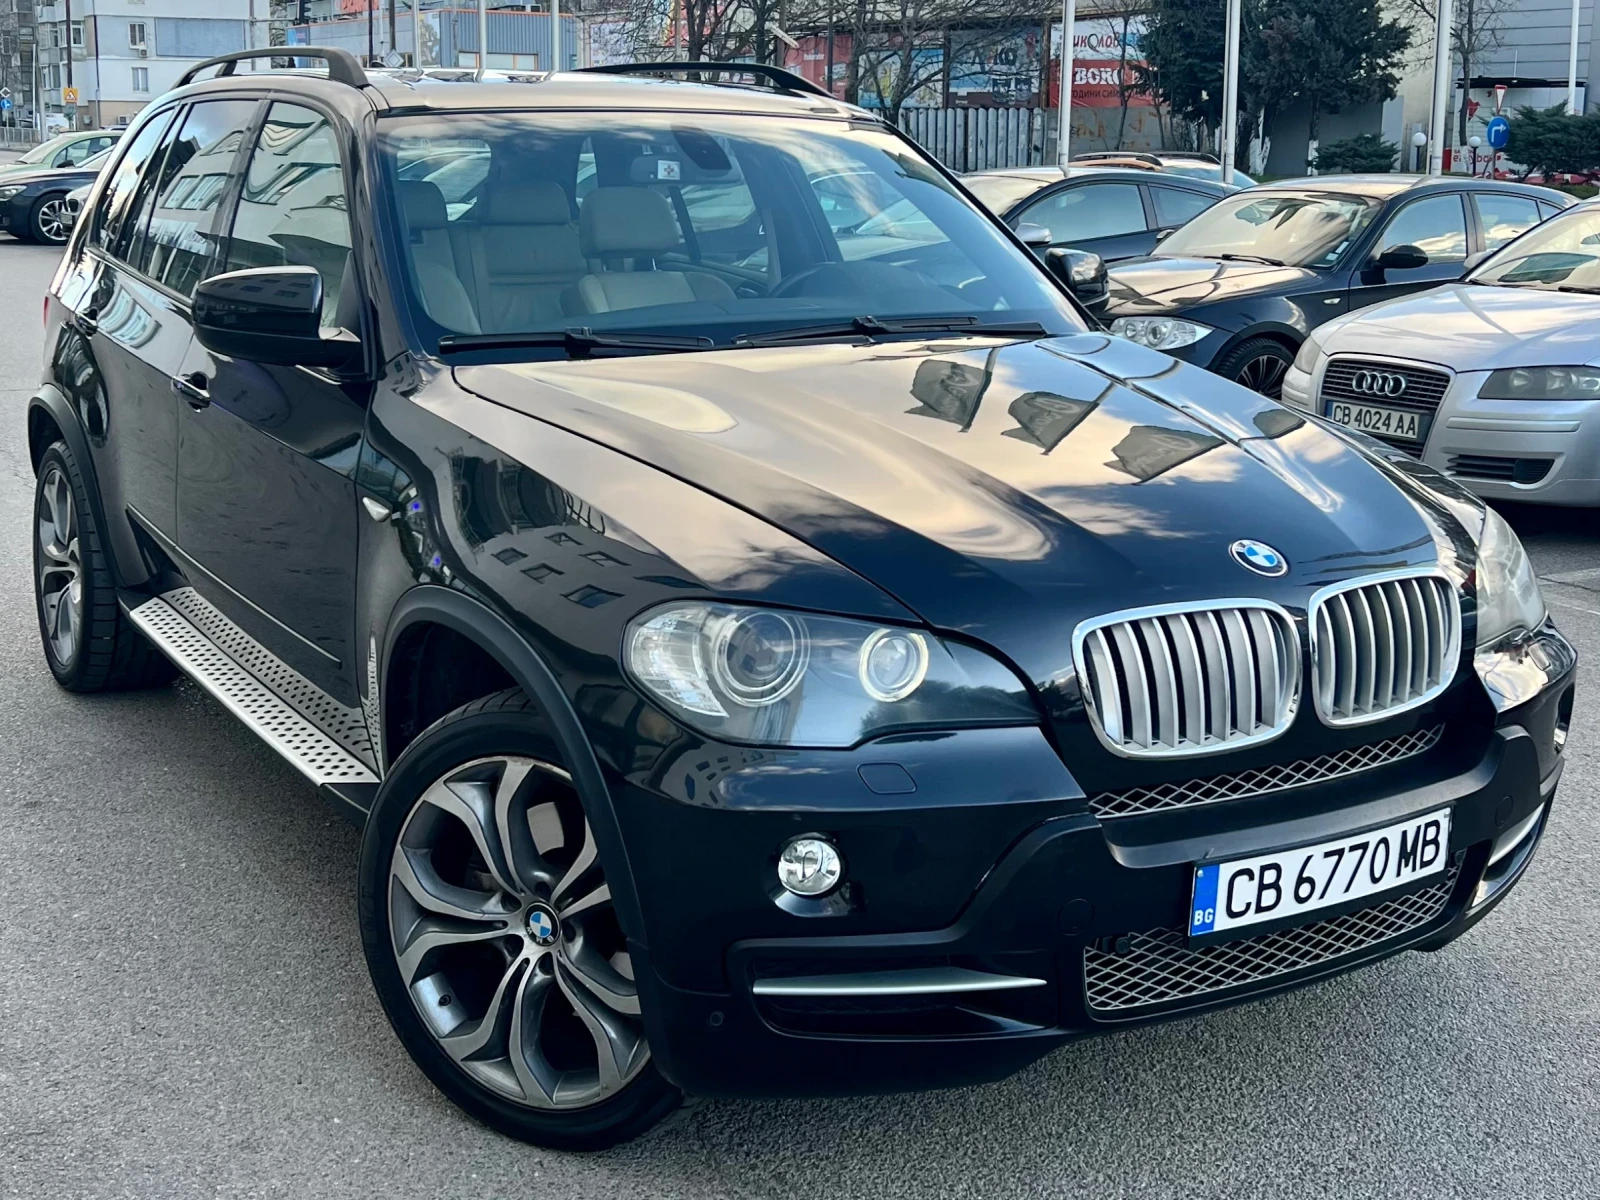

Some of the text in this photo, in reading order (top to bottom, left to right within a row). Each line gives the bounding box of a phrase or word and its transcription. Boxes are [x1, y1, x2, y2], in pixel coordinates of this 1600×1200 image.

[1070, 89, 1101, 99] ОДИНИ
[1333, 405, 1416, 436] CB 4024 AA
[1225, 819, 1441, 919] CB 6770 MB
[1194, 908, 1214, 927] BG
